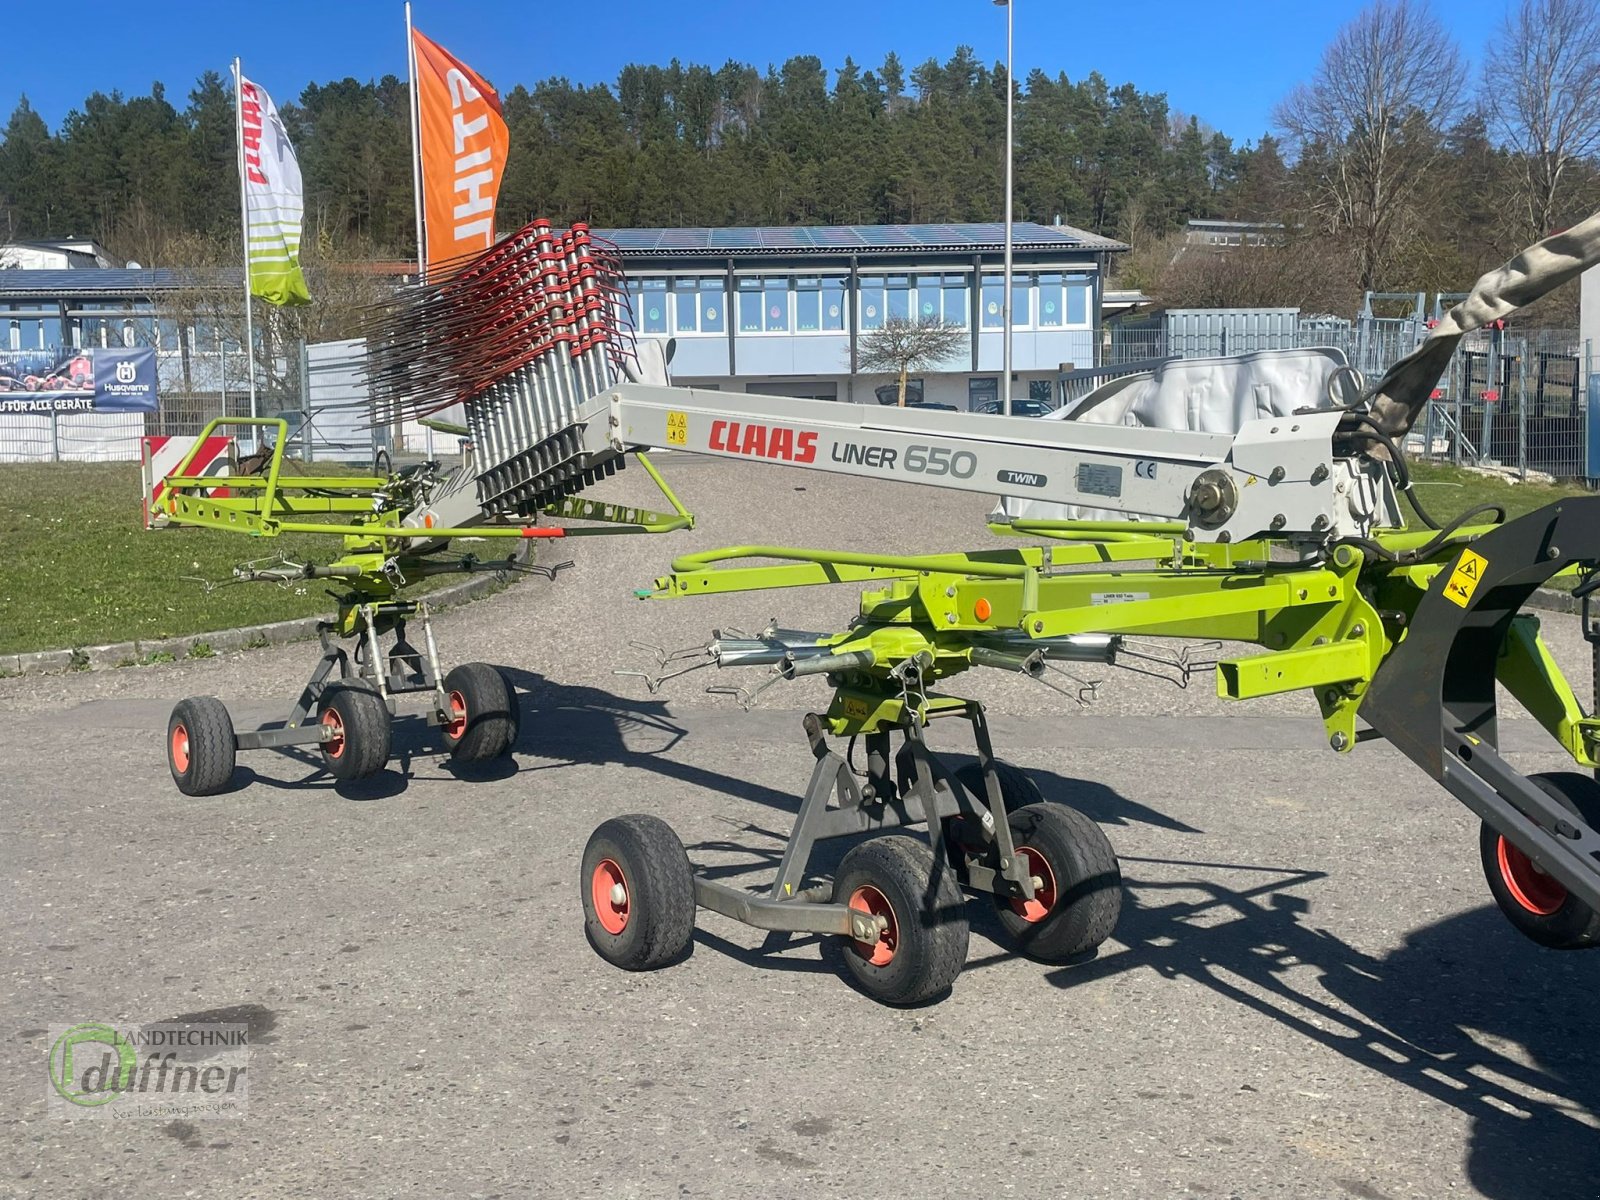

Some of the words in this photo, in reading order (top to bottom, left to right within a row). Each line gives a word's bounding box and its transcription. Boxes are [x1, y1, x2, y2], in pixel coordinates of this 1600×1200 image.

[104, 383, 149, 393] Husqvarna
[8, 399, 28, 412] FÜR
[29, 400, 52, 411] ALLE
[54, 397, 93, 410] GERÄTE
[708, 420, 819, 464] CLAAS
[831, 442, 898, 470] LINER
[903, 444, 978, 480] 650
[1006, 471, 1038, 485] TWIN
[1135, 461, 1155, 479] CE
